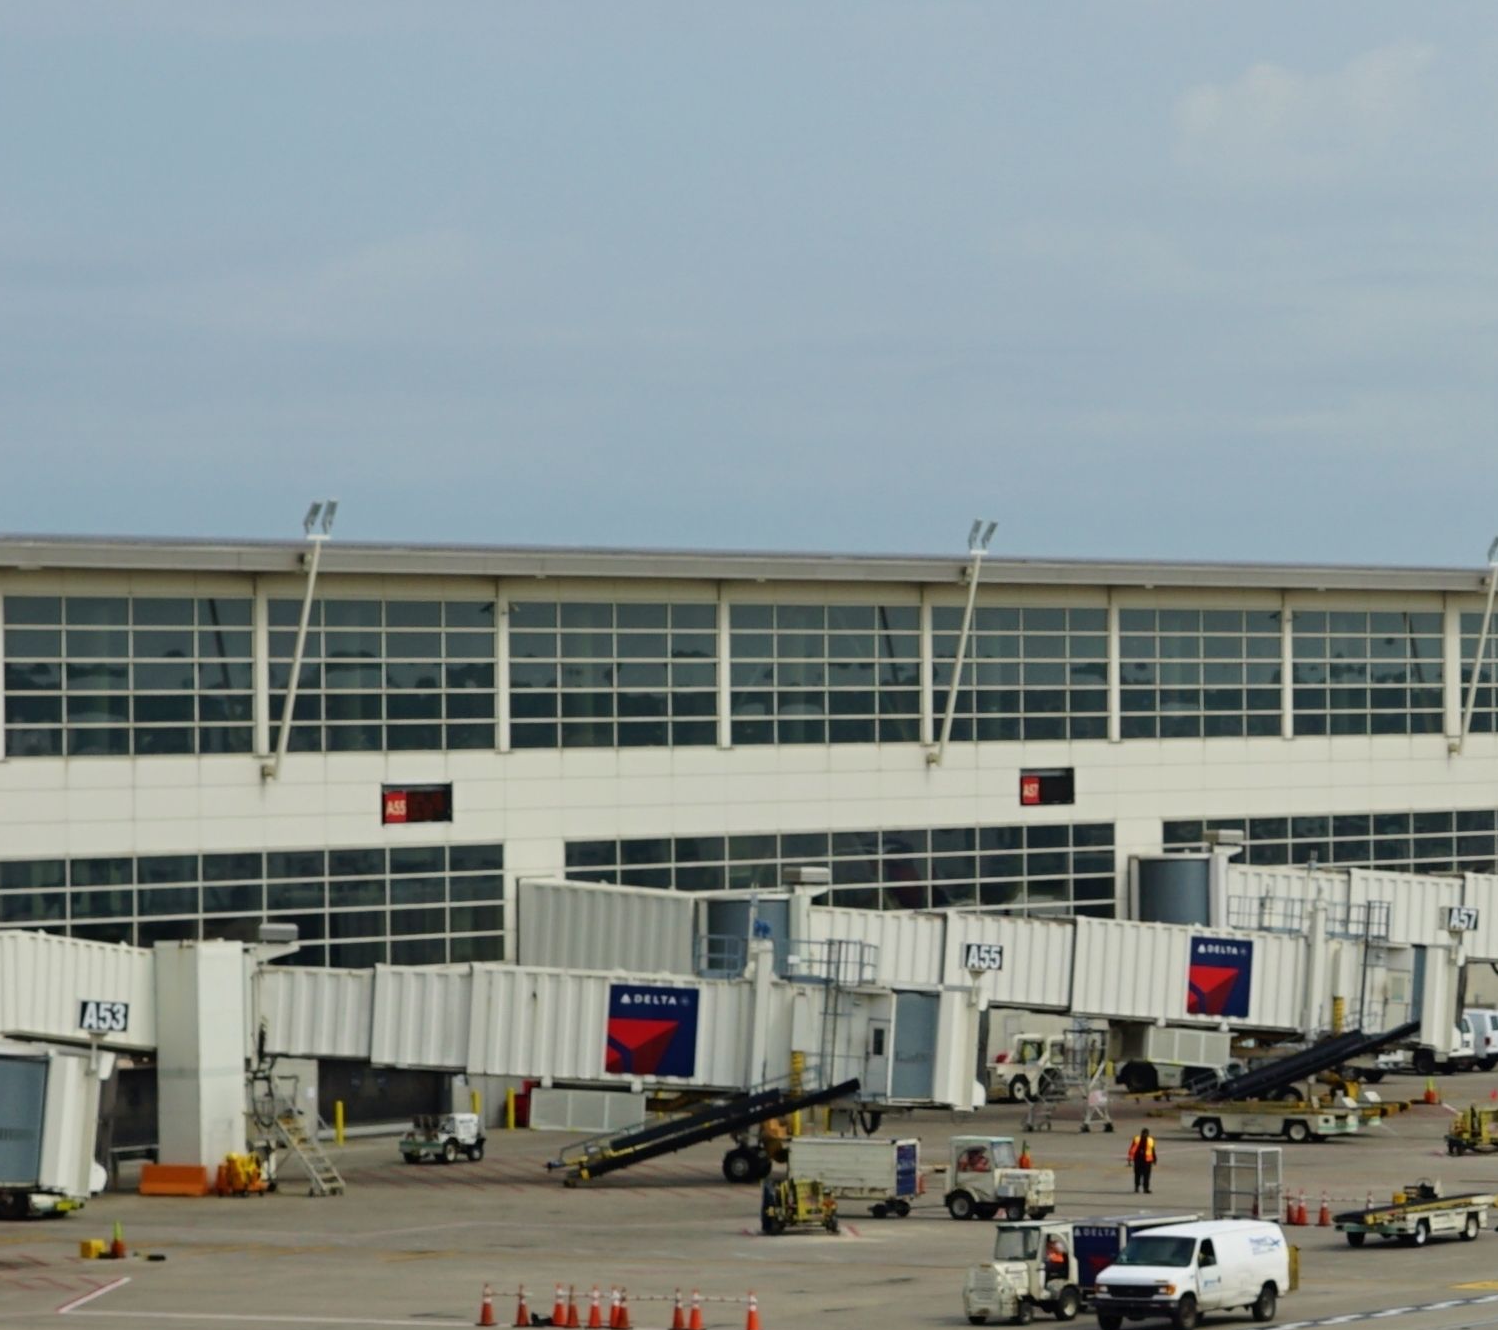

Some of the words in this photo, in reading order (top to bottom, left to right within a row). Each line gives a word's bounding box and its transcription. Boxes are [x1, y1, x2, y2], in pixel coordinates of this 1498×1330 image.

[386, 799, 407, 816] A55
[1450, 908, 1477, 929] A57
[967, 945, 1001, 970] A55
[1207, 943, 1238, 956] DELTA
[633, 993, 677, 1006] DELTA
[82, 1002, 126, 1030] A53
[1083, 1227, 1117, 1238] DELTA
